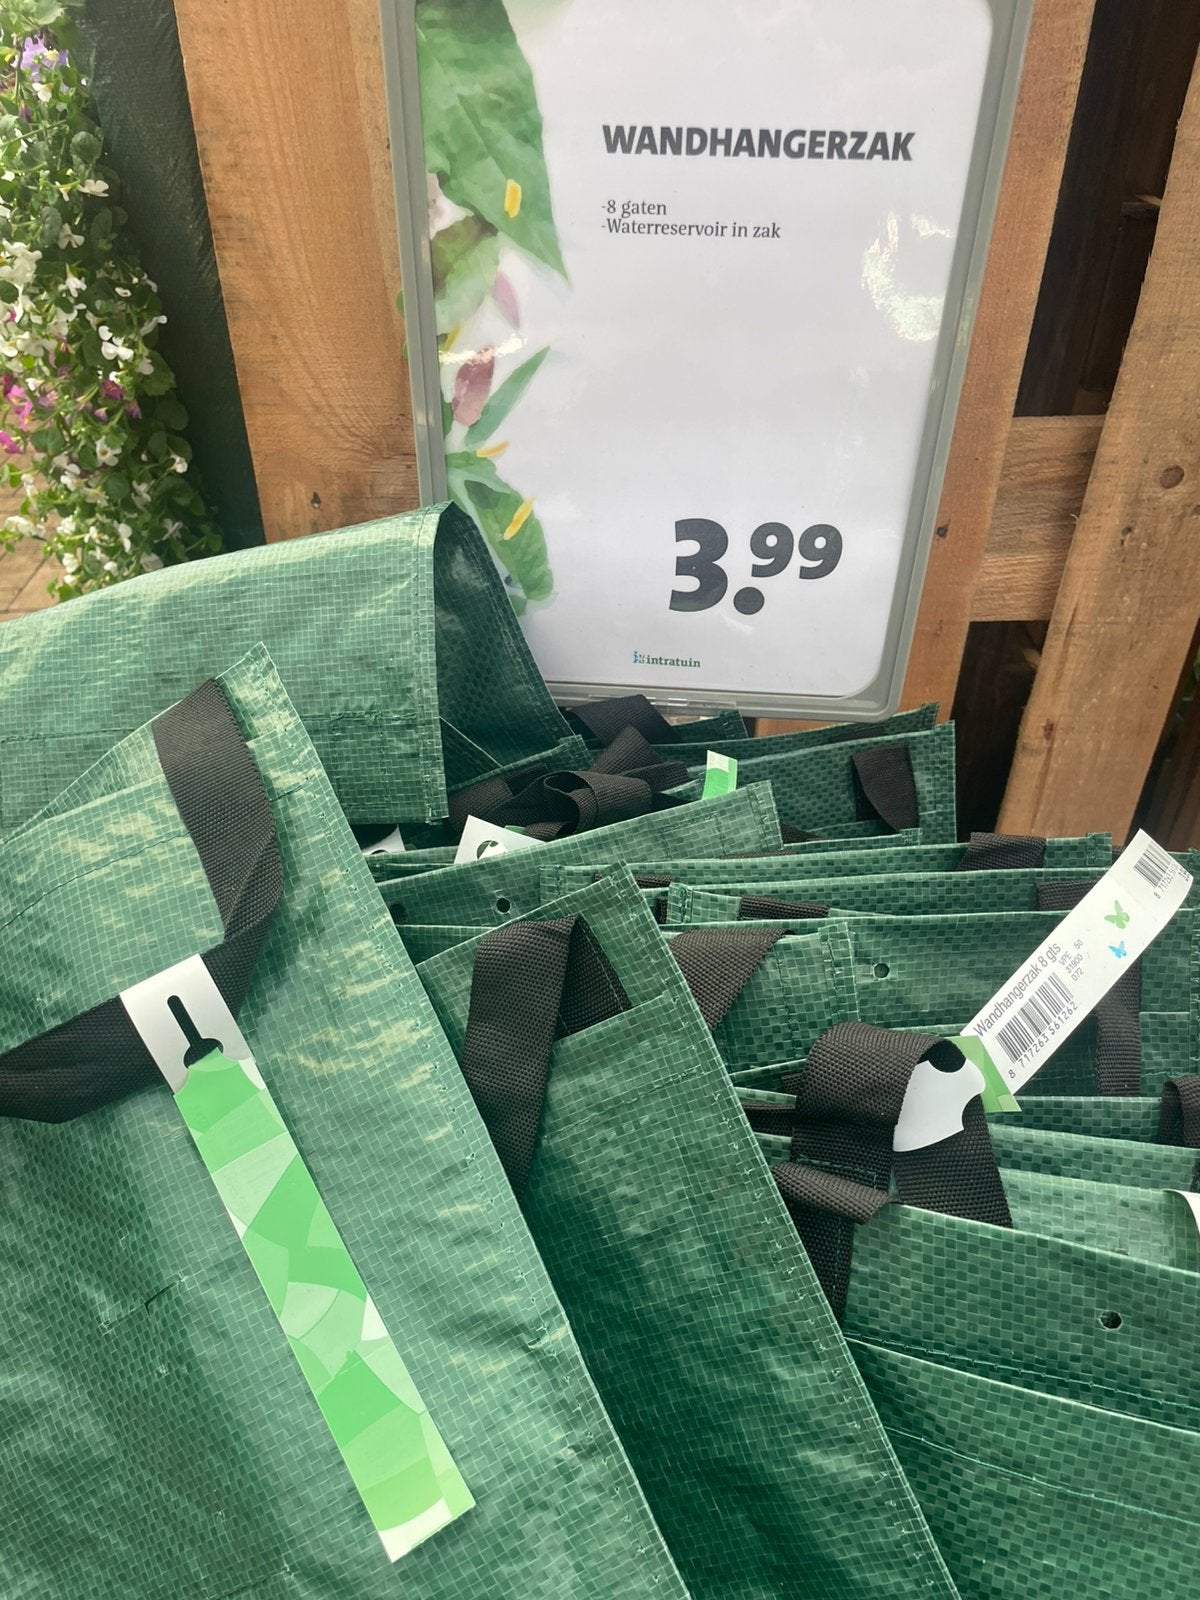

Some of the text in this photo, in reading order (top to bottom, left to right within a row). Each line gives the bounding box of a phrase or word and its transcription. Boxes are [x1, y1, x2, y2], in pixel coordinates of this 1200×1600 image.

[602, 124, 916, 162] WANDHANGERZAK
[621, 200, 667, 218] gaten
[601, 218, 781, 239] -Waterreservoir in zak
[646, 654, 701, 668] intratuin
[972, 942, 1062, 1038] Wandhangerzak 8 gts
[1008, 1001, 1078, 1079] 8 717263 561262
